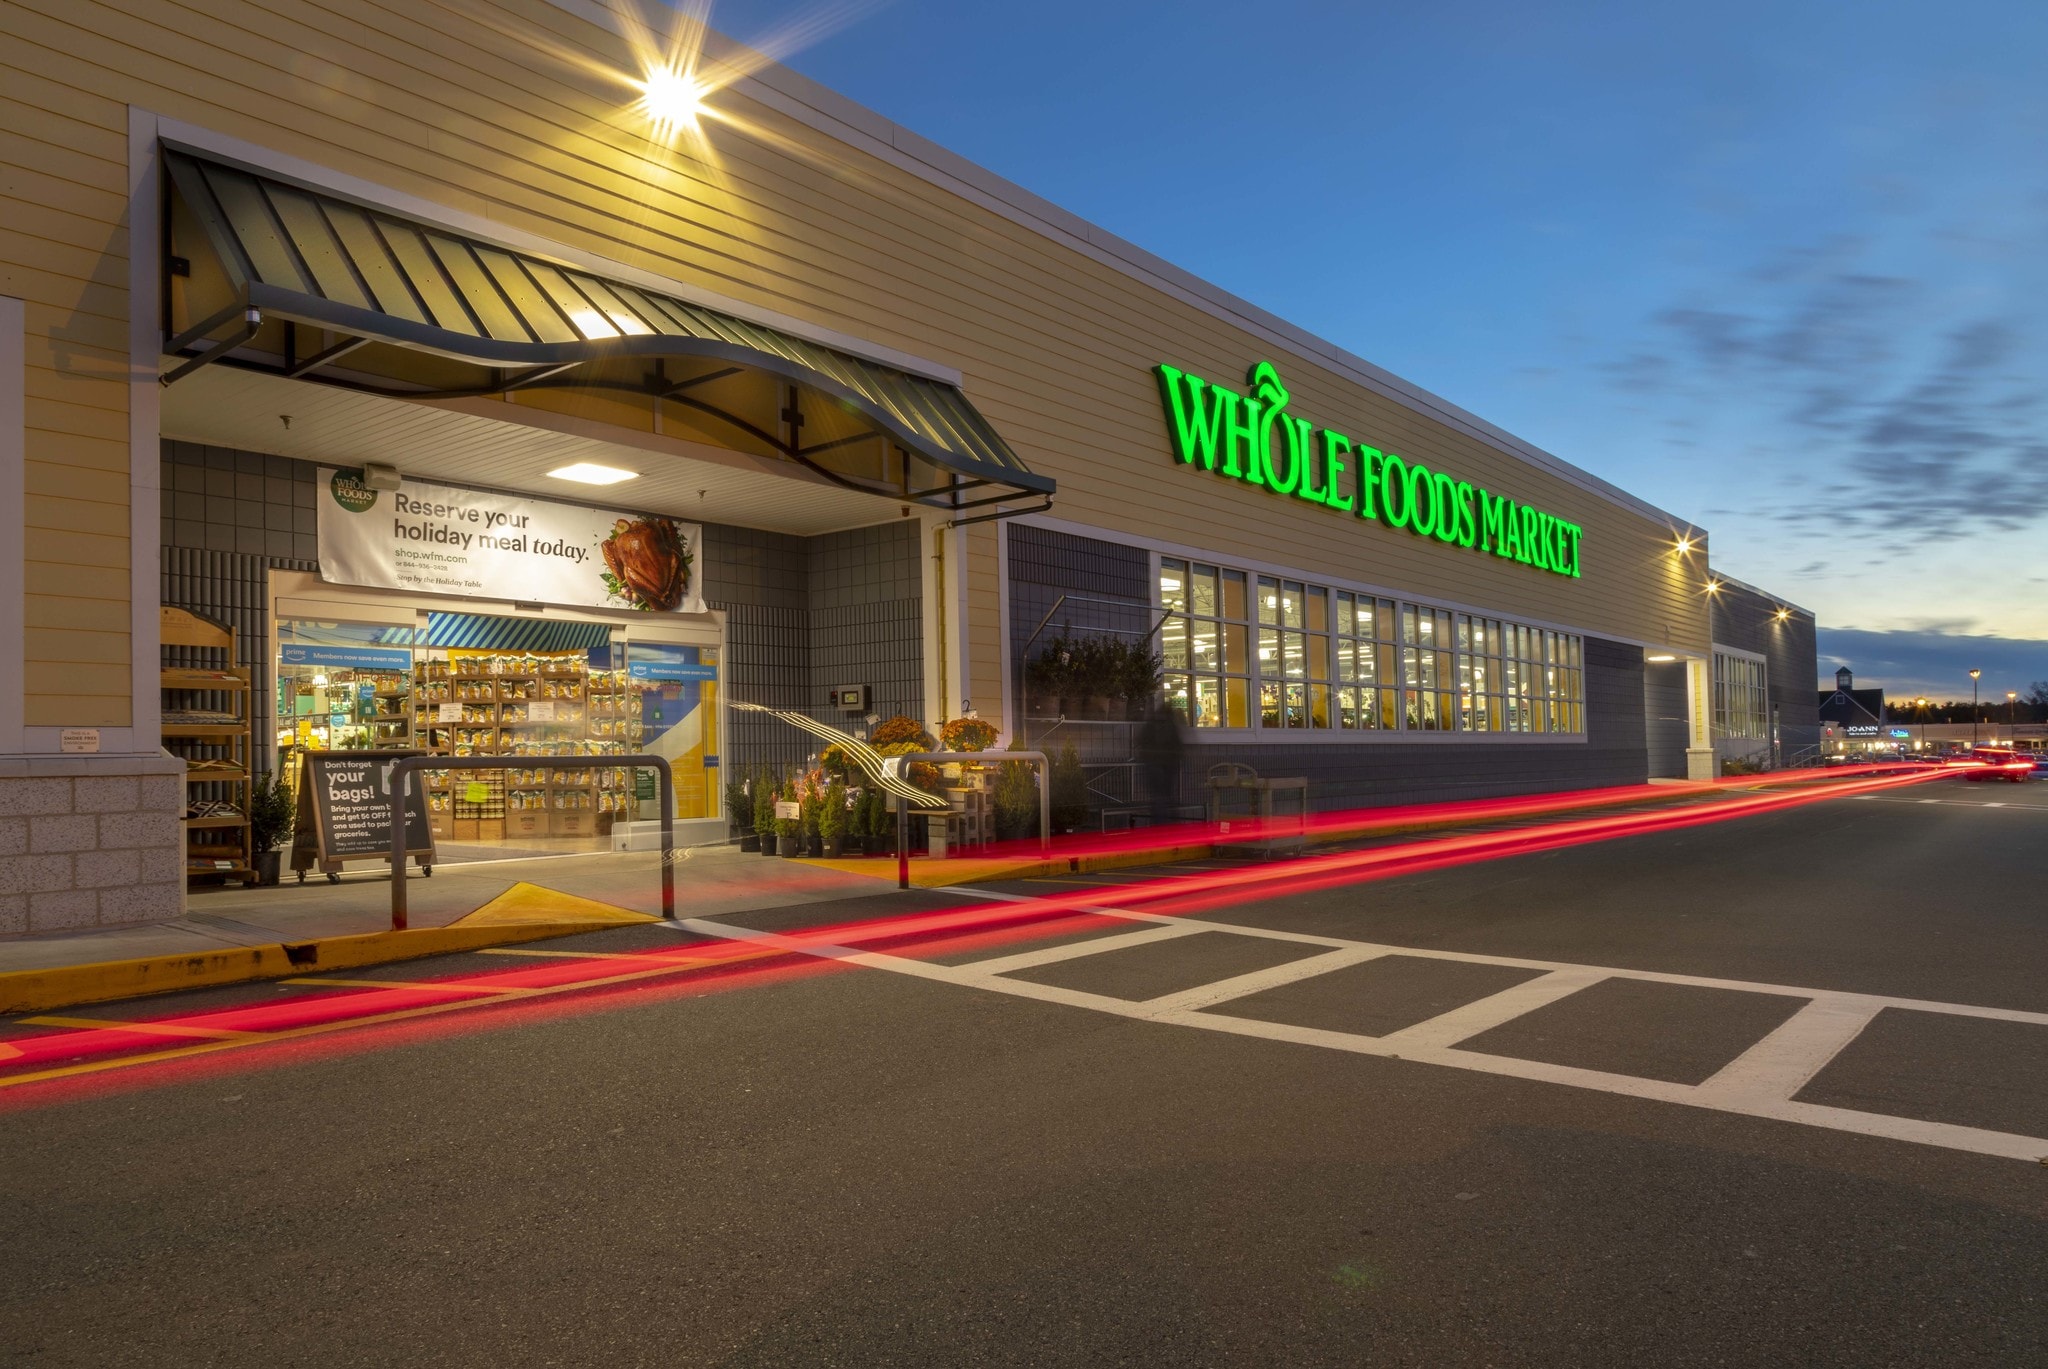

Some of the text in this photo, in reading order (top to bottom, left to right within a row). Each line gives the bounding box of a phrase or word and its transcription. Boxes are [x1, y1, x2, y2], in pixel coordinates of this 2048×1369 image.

[1152, 361, 1582, 578] WHOLE FOODS MARKET
[336, 476, 367, 490] WHOL
[338, 488, 372, 500] FOODS
[395, 492, 530, 528] Reserve your
[394, 518, 589, 564] holiday meal today.
[395, 548, 468, 564] shop.wfm.com
[396, 574, 412, 582] Stop
[414, 575, 422, 583] by
[436, 578, 463, 588] Holiday
[348, 761, 372, 769] forget
[326, 772, 365, 786] your
[328, 786, 374, 802] bags!
[334, 830, 371, 839] groceries.
